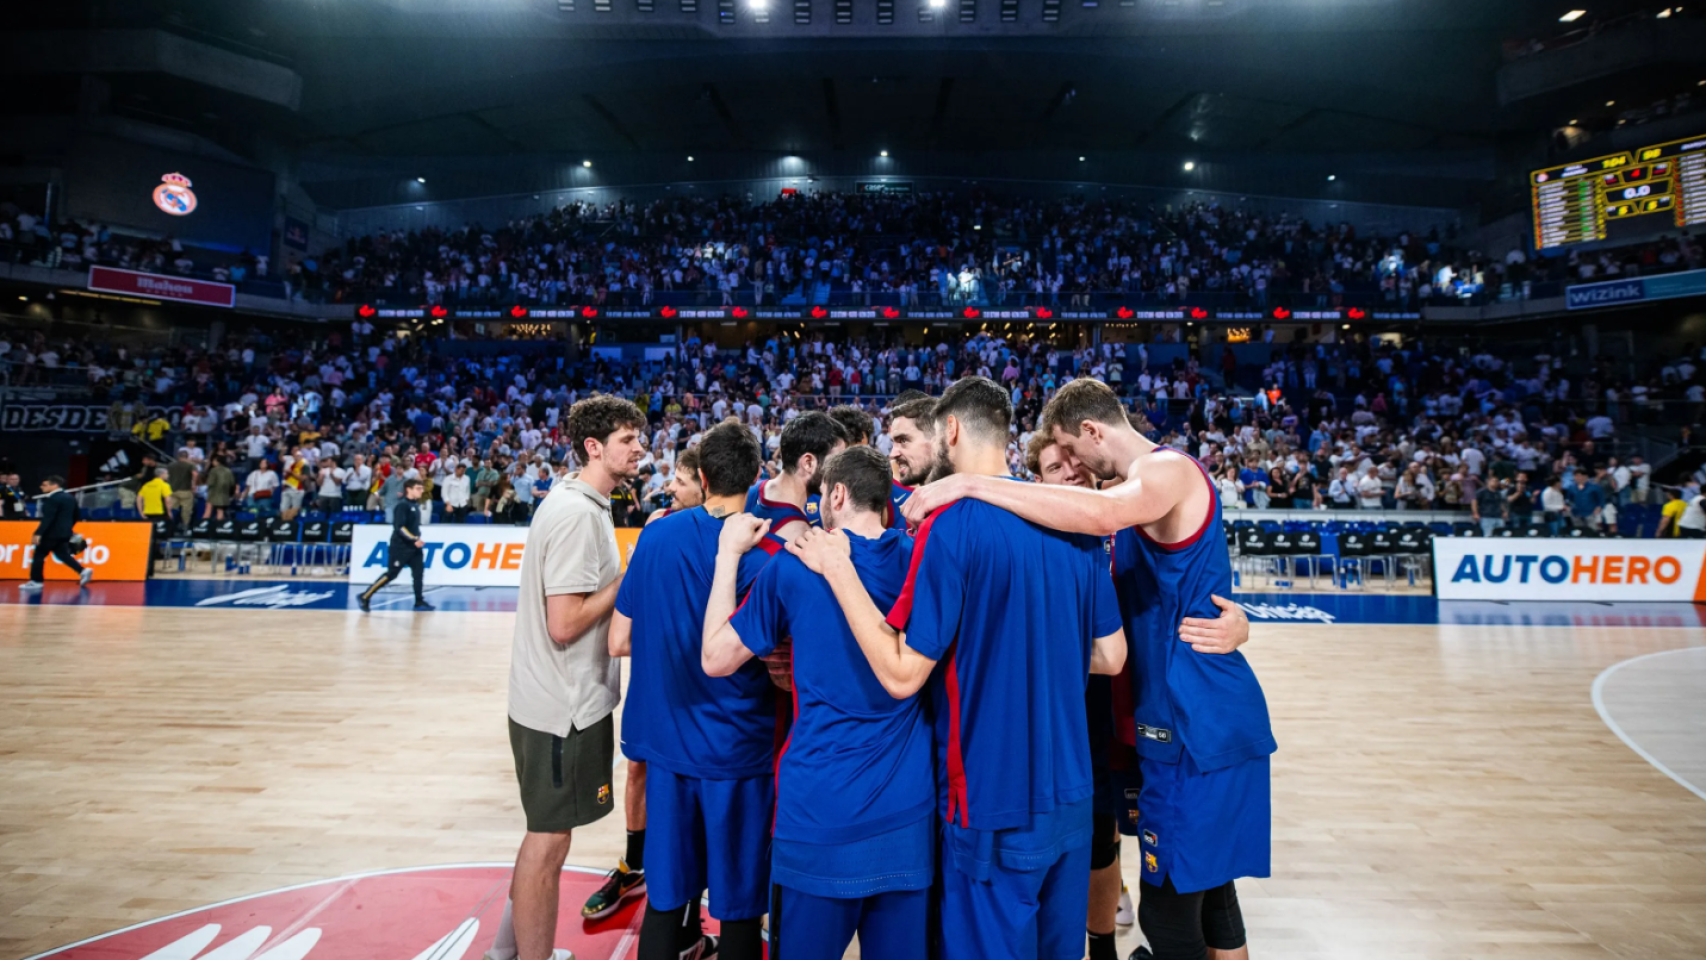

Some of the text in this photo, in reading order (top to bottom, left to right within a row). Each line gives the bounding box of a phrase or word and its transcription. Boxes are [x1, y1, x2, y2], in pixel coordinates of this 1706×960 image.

[137, 276, 193, 294] Mahou
[3, 405, 107, 432] DESDE
[1451, 554, 1682, 585] AUTOHERO
